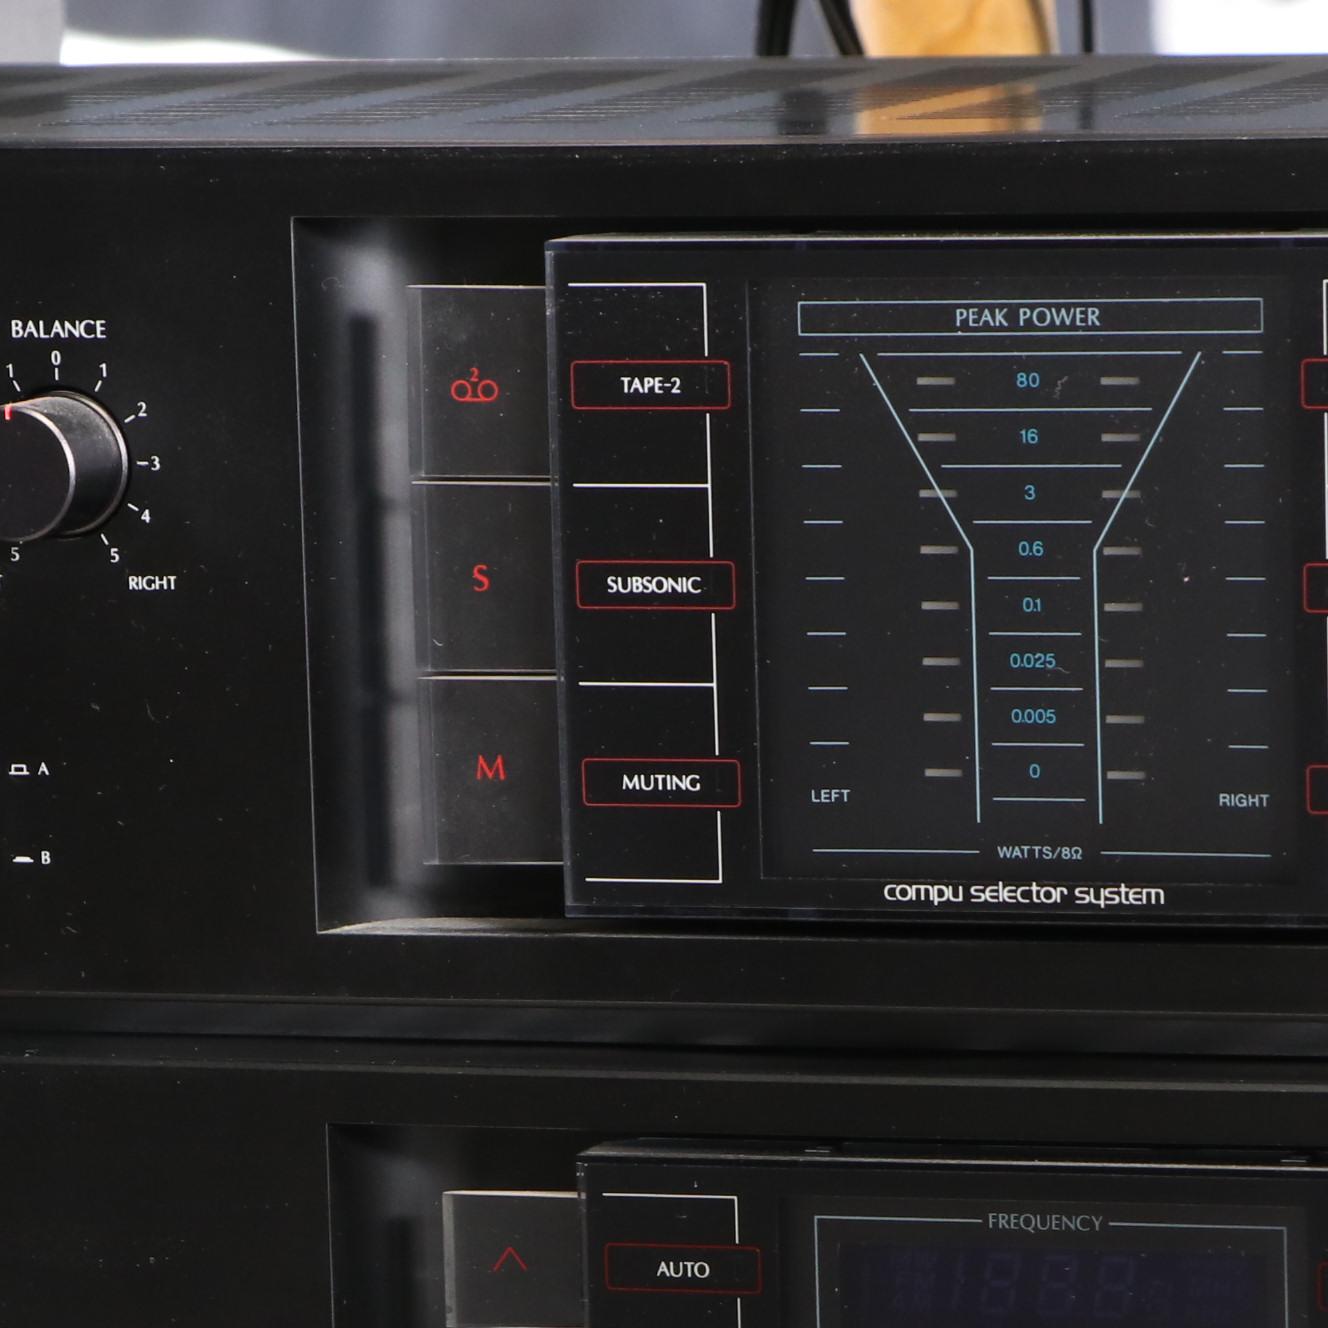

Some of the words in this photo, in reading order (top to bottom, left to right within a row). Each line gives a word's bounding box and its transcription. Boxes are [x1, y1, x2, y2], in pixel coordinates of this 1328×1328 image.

[955, 308, 1009, 327] PEAK
[1019, 307, 1101, 327] POWER
[11, 319, 107, 339] BALANCE
[620, 376, 681, 394] TAPE-2
[1016, 372, 1040, 388] 80
[1019, 428, 1039, 445] 16
[1018, 540, 1044, 557] 0.6
[128, 575, 177, 591] RIGHT
[607, 576, 702, 594] SUBSONIC
[1009, 652, 1056, 669] 0.025
[1011, 708, 1057, 724] 0.005
[622, 774, 701, 792] MUTING
[883, 884, 964, 906] compu
[969, 880, 1068, 904] selector
[1074, 882, 1165, 909] system
[988, 1212, 1103, 1234] FREQUENCY
[656, 1261, 710, 1279] AUTO
